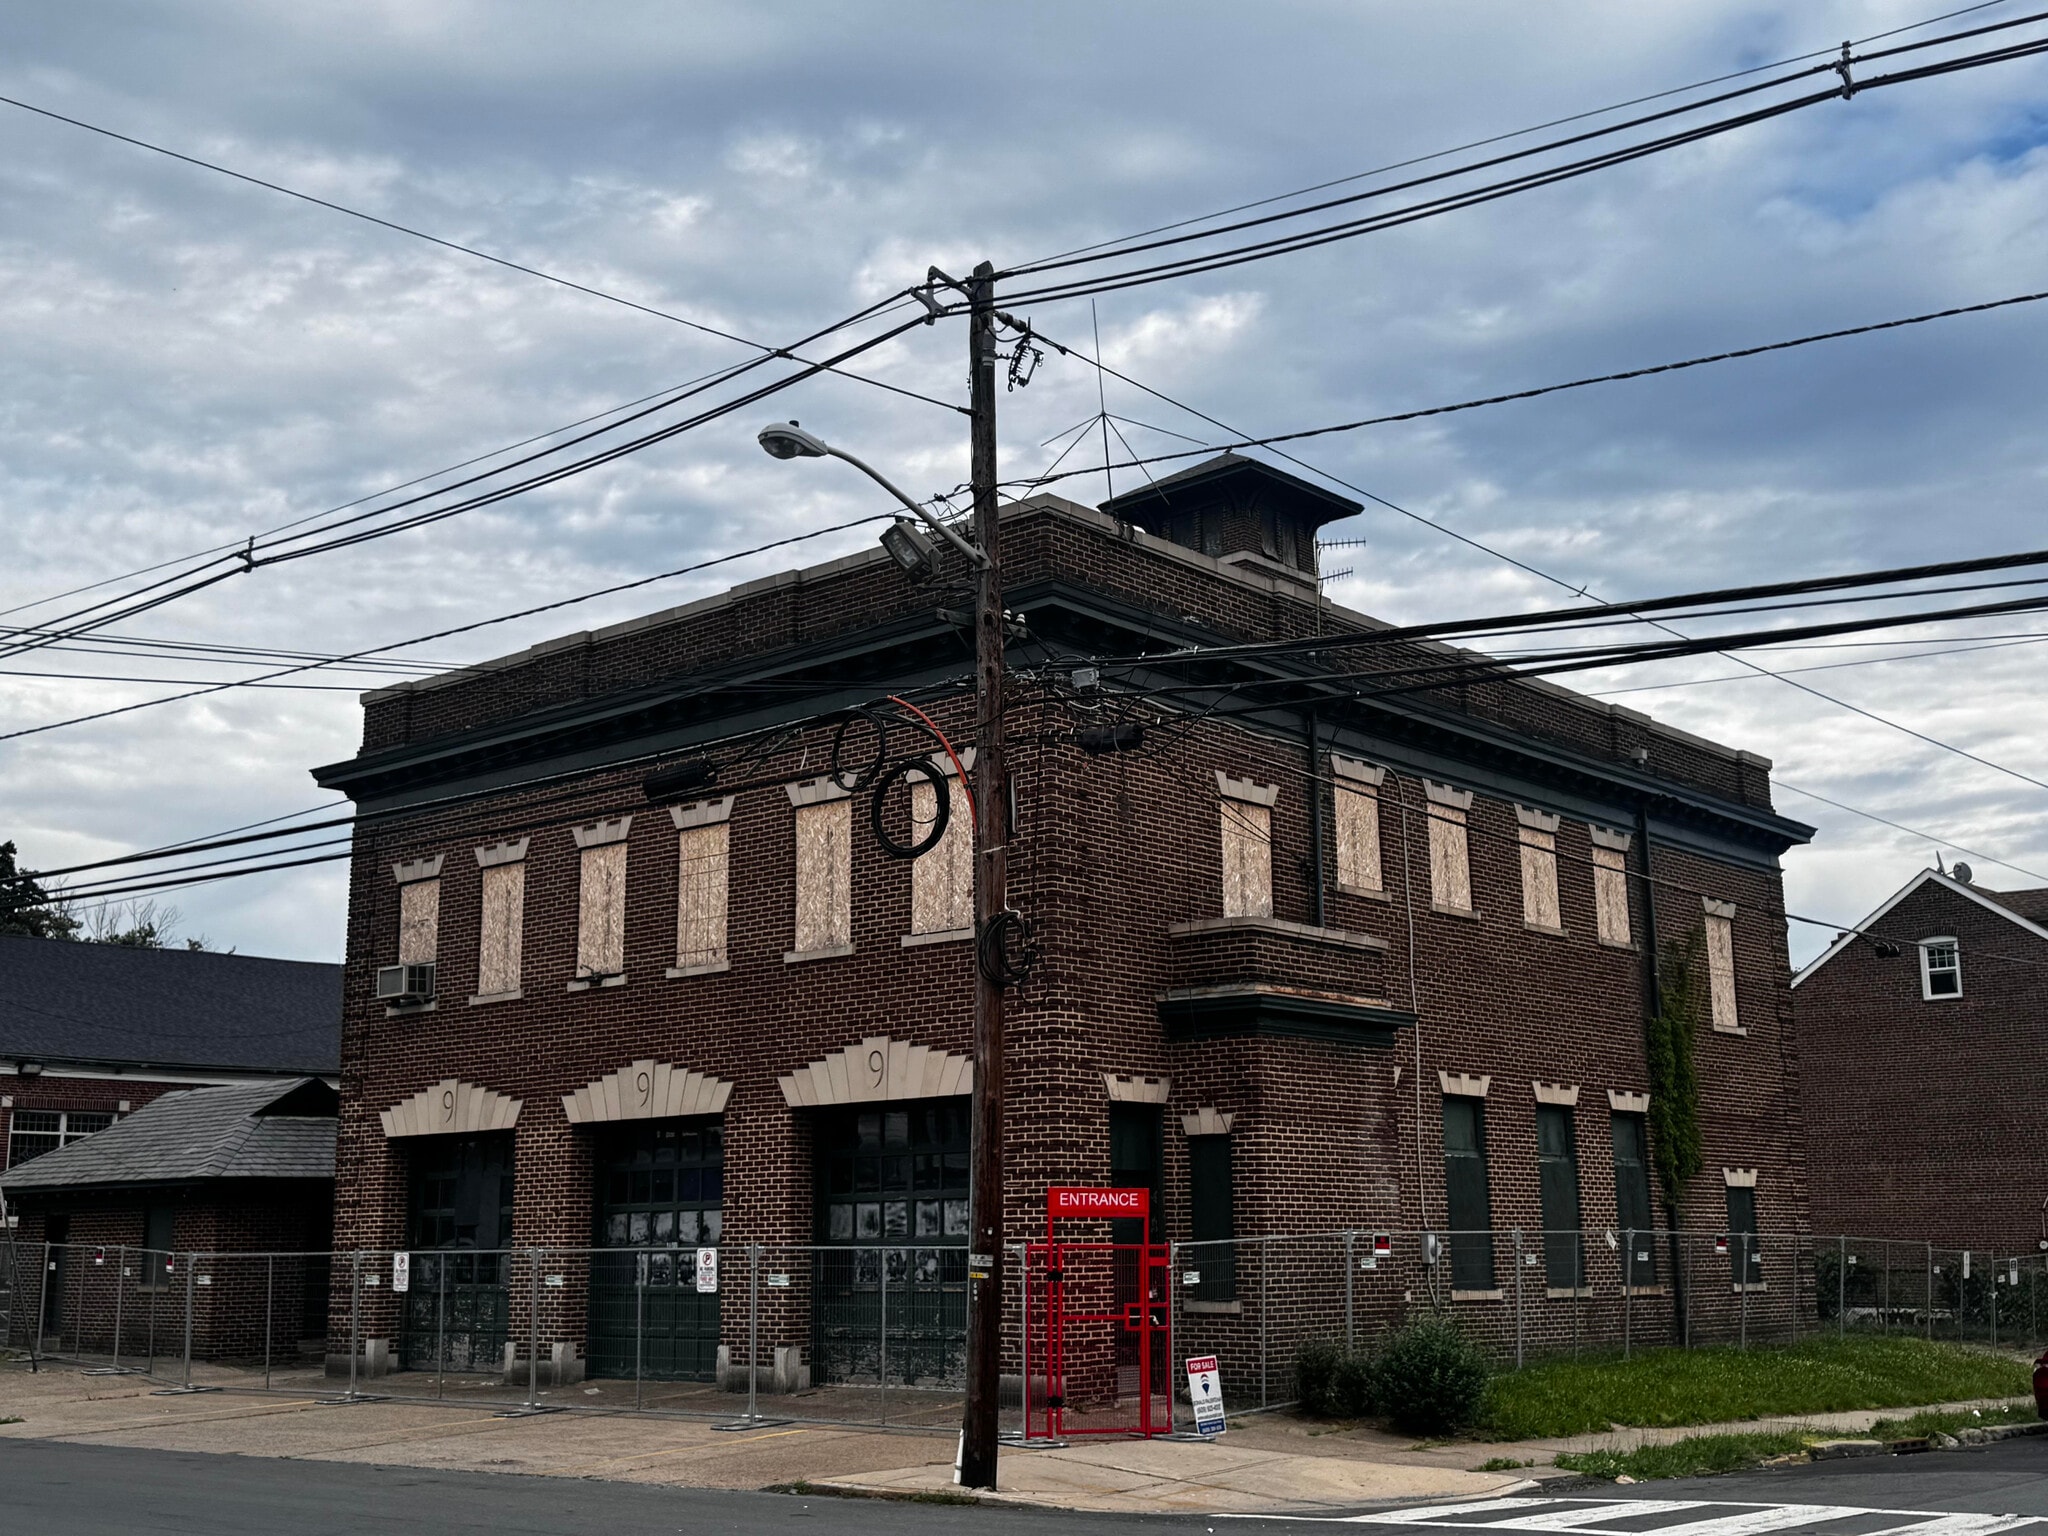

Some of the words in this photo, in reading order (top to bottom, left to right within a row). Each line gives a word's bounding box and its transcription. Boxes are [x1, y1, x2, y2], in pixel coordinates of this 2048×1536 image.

[868, 1050, 884, 1089] 9
[442, 1090, 454, 1123] 9
[636, 1072, 650, 1108] 9
[1059, 1192, 1139, 1206] ENTRANCE
[1190, 1362, 1201, 1372] FOR
[1201, 1360, 1215, 1370] SALE
